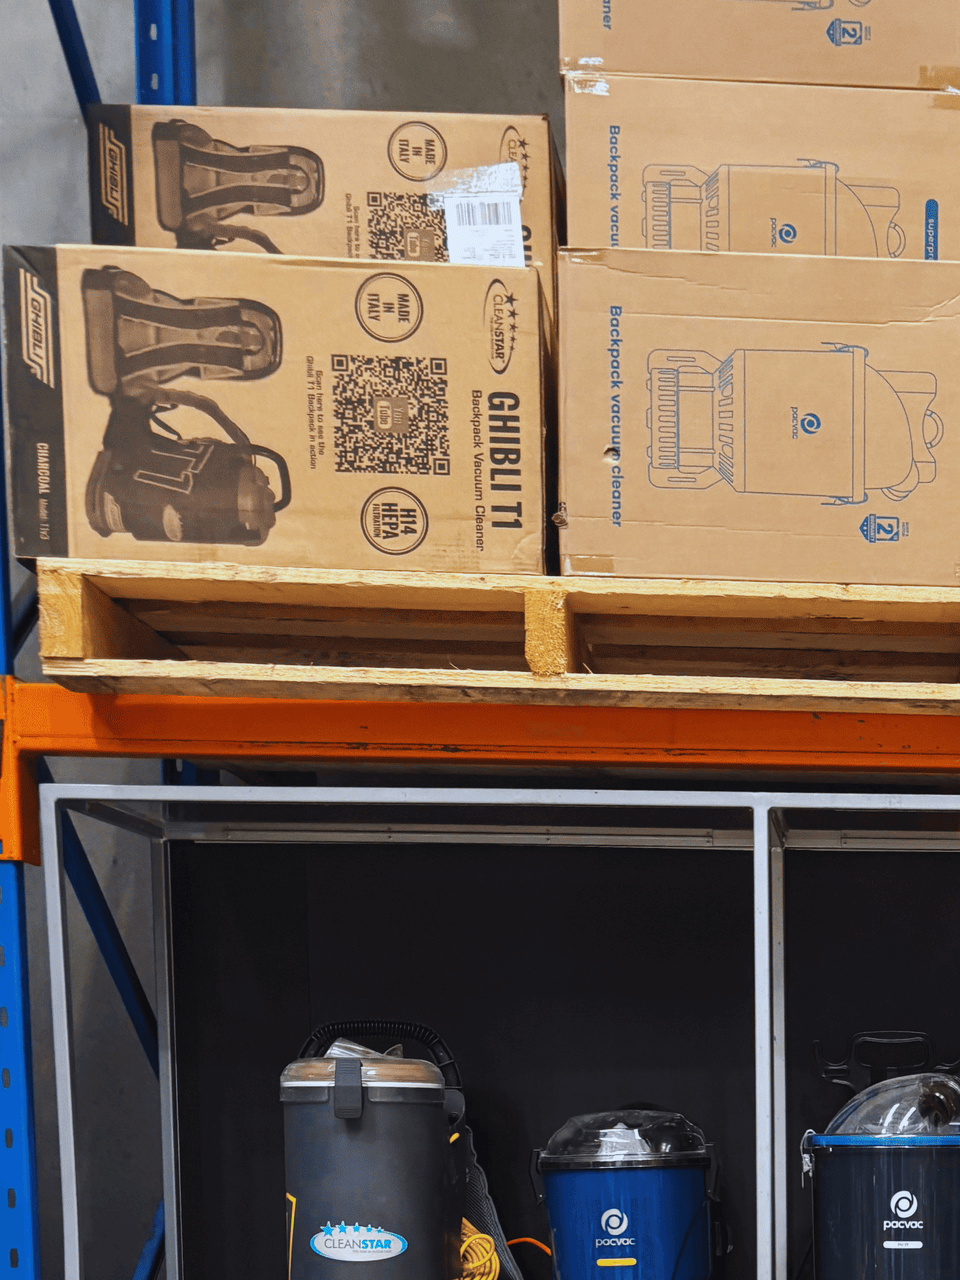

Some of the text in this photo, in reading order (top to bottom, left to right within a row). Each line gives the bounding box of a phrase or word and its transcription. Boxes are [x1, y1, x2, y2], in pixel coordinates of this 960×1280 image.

[398, 139, 410, 164] ITALY
[412, 146, 423, 158] IN
[424, 139, 436, 166] MADE
[607, 125, 621, 247] Backpack vacu
[366, 293, 381, 322] ITALY
[382, 302, 395, 313] IN
[397, 293, 411, 323] MADE
[493, 294, 505, 360] CLEANSTAR
[606, 305, 623, 390] Backpack
[315, 370, 324, 391] Scan
[306, 393, 316, 434] Backpack
[790, 406, 799, 440] pacvac
[36, 442, 51, 495] CHARCOAL
[308, 444, 316, 470] action
[470, 389, 486, 552] Backpack Vacuum Cleaner
[487, 391, 523, 529] GHIBLI T1
[611, 464, 625, 527] cleaner
[371, 503, 382, 538] FILTRATION
[381, 503, 400, 540] HEPA
[399, 508, 418, 536] H14
[883, 1220, 924, 1231] pacvac
[324, 1238, 392, 1249] CLEANSTAR
[595, 1238, 636, 1248] pacvac
